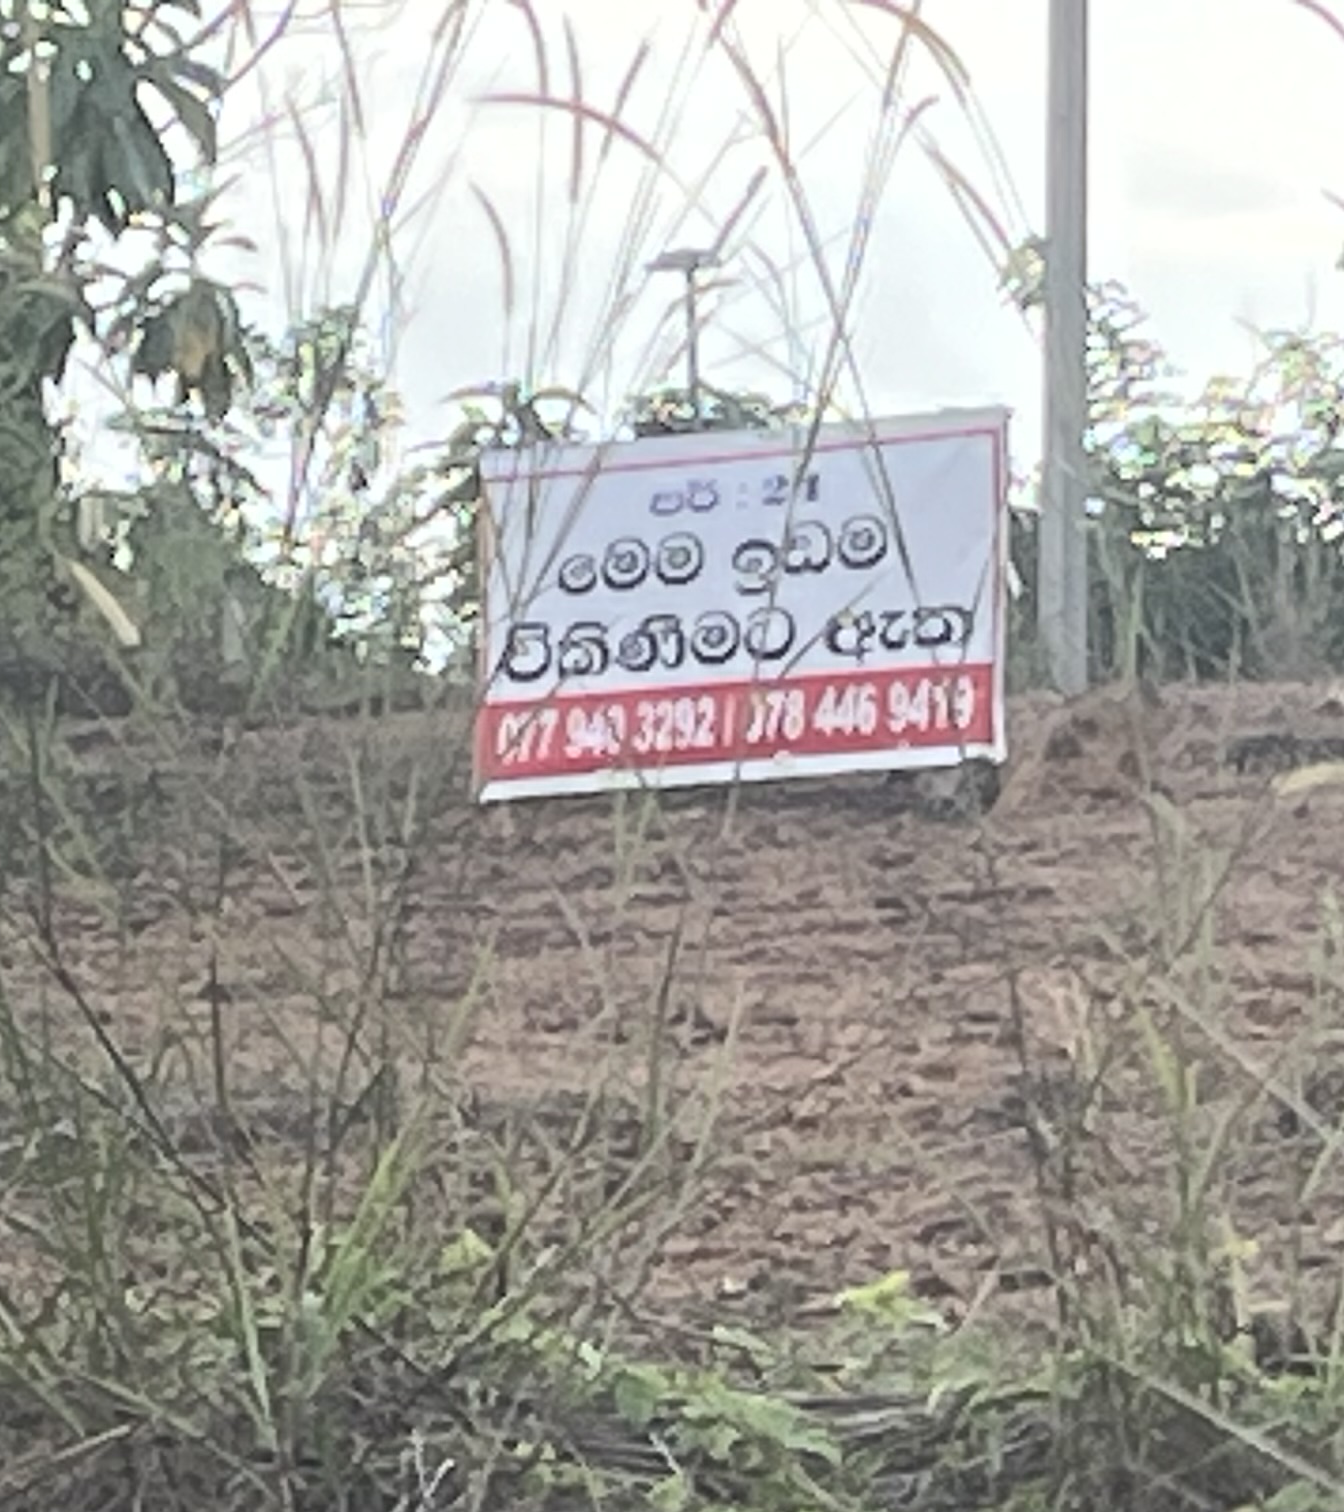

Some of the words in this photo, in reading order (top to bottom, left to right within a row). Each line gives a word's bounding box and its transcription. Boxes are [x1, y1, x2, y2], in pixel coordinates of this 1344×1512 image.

[558, 530, 704, 595] මෙම
[732, 514, 888, 597] ඉඩම
[632, 697, 715, 752] 3292
[812, 681, 877, 737] 446
